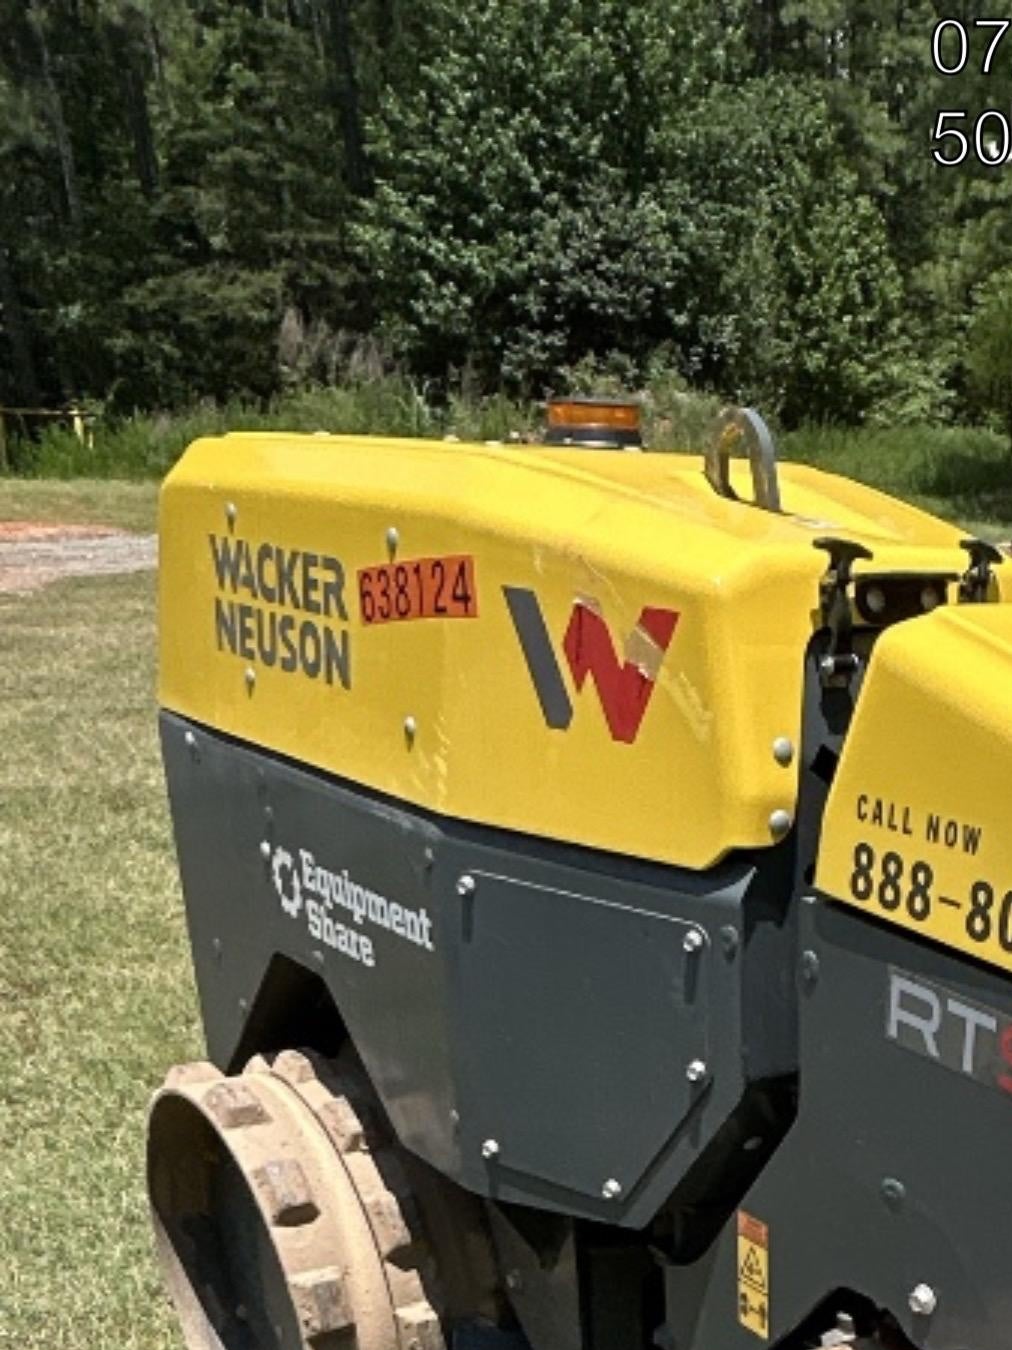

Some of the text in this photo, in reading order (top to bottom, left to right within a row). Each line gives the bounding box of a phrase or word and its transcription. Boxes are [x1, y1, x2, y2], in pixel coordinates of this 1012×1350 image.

[209, 534, 349, 622] WACKER
[359, 559, 472, 623] 638124
[215, 597, 351, 690] NEUSON
[856, 794, 982, 856] CALL NOW
[299, 849, 434, 951] Equipment
[305, 900, 375, 967] Share
